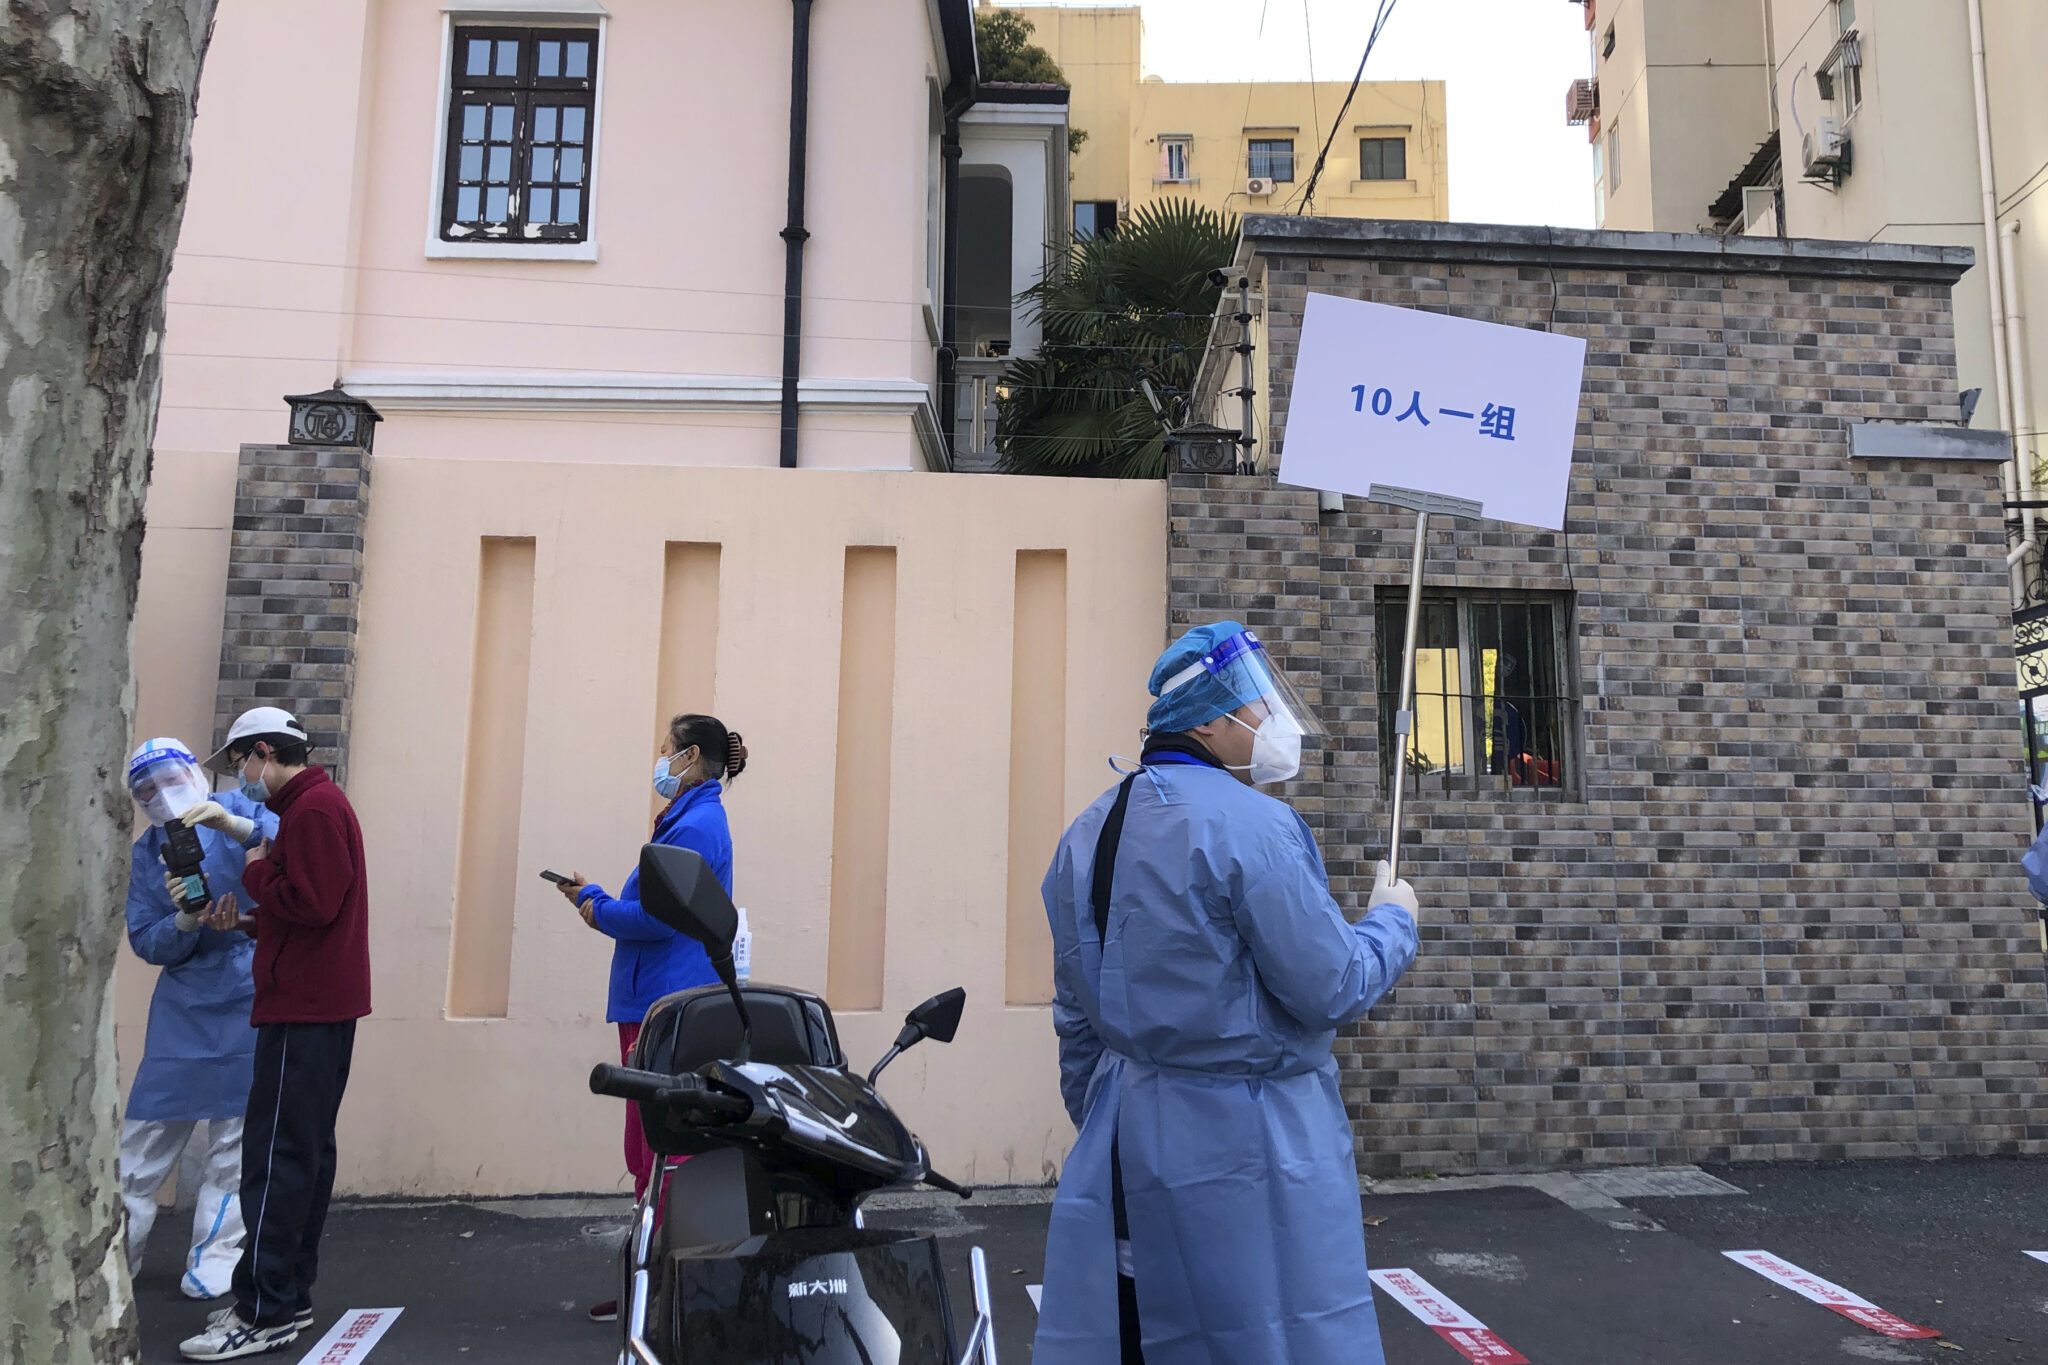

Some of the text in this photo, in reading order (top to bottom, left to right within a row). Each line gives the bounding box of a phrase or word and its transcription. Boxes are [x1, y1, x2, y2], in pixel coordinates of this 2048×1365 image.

[1351, 384, 1516, 441] 10人一组
[788, 1279, 848, 1298] 新大洲
